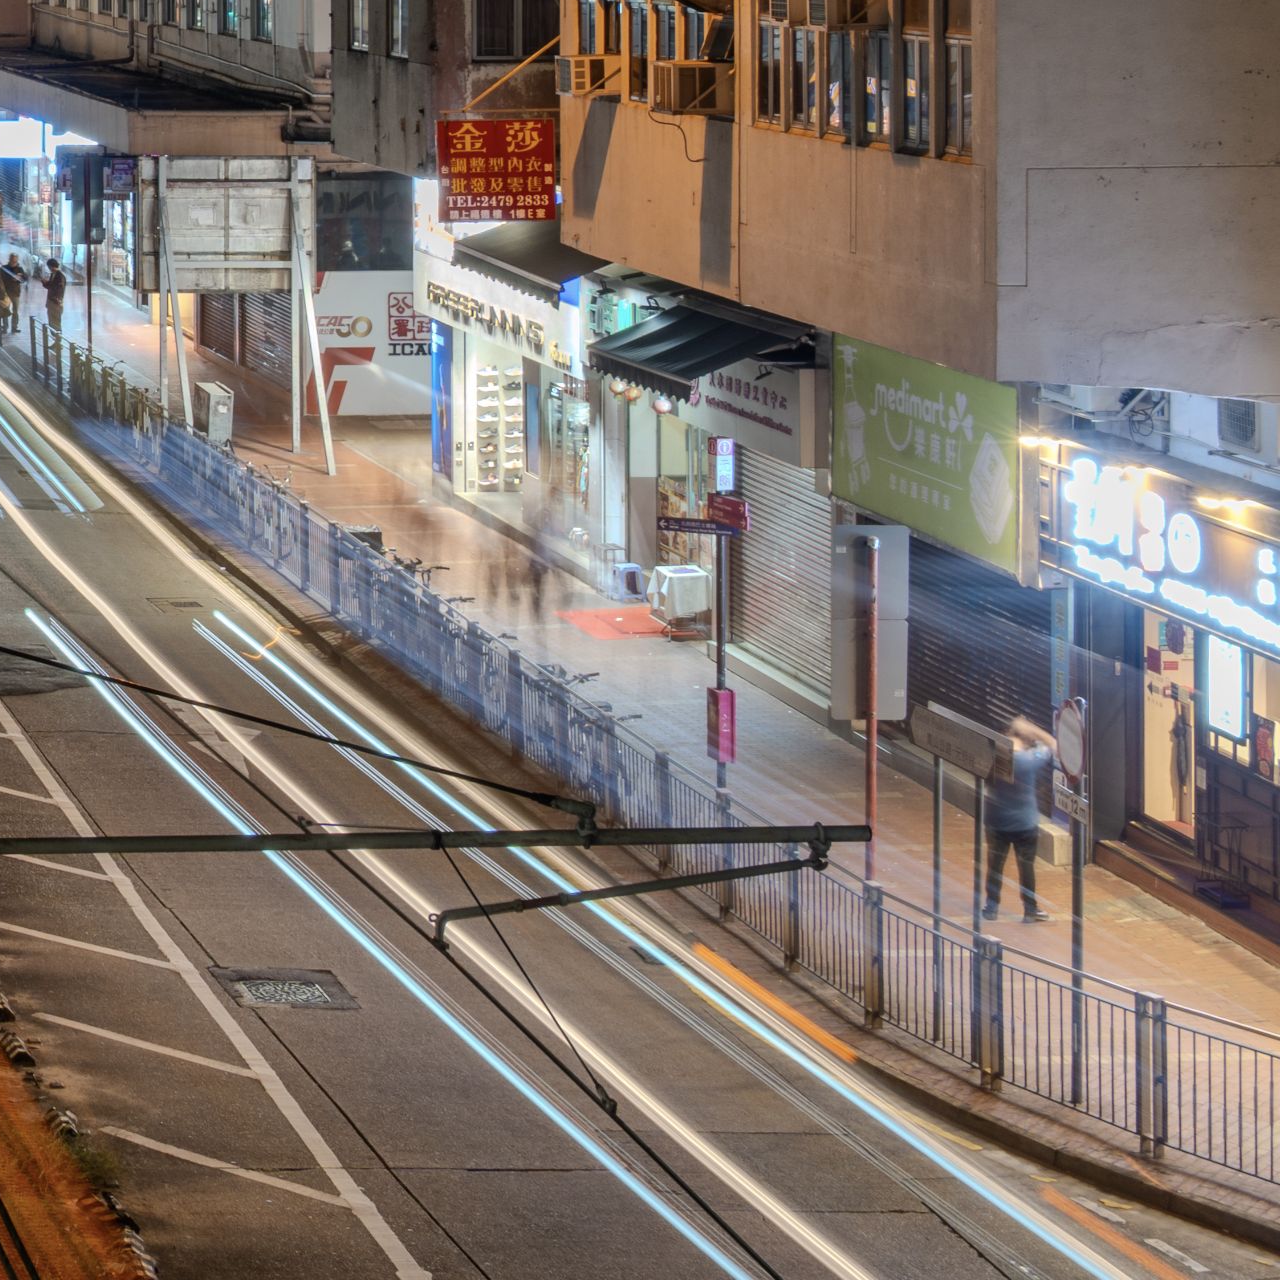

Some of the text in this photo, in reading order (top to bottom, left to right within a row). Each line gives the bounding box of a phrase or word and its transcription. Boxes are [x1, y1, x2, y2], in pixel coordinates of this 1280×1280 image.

[448, 122, 543, 154] 金莎
[450, 157, 542, 175] 調整型內衣
[451, 176, 543, 194] 批發及零售
[446, 194, 550, 208] TEL:2479 2833
[870, 378, 947, 428] medimart
